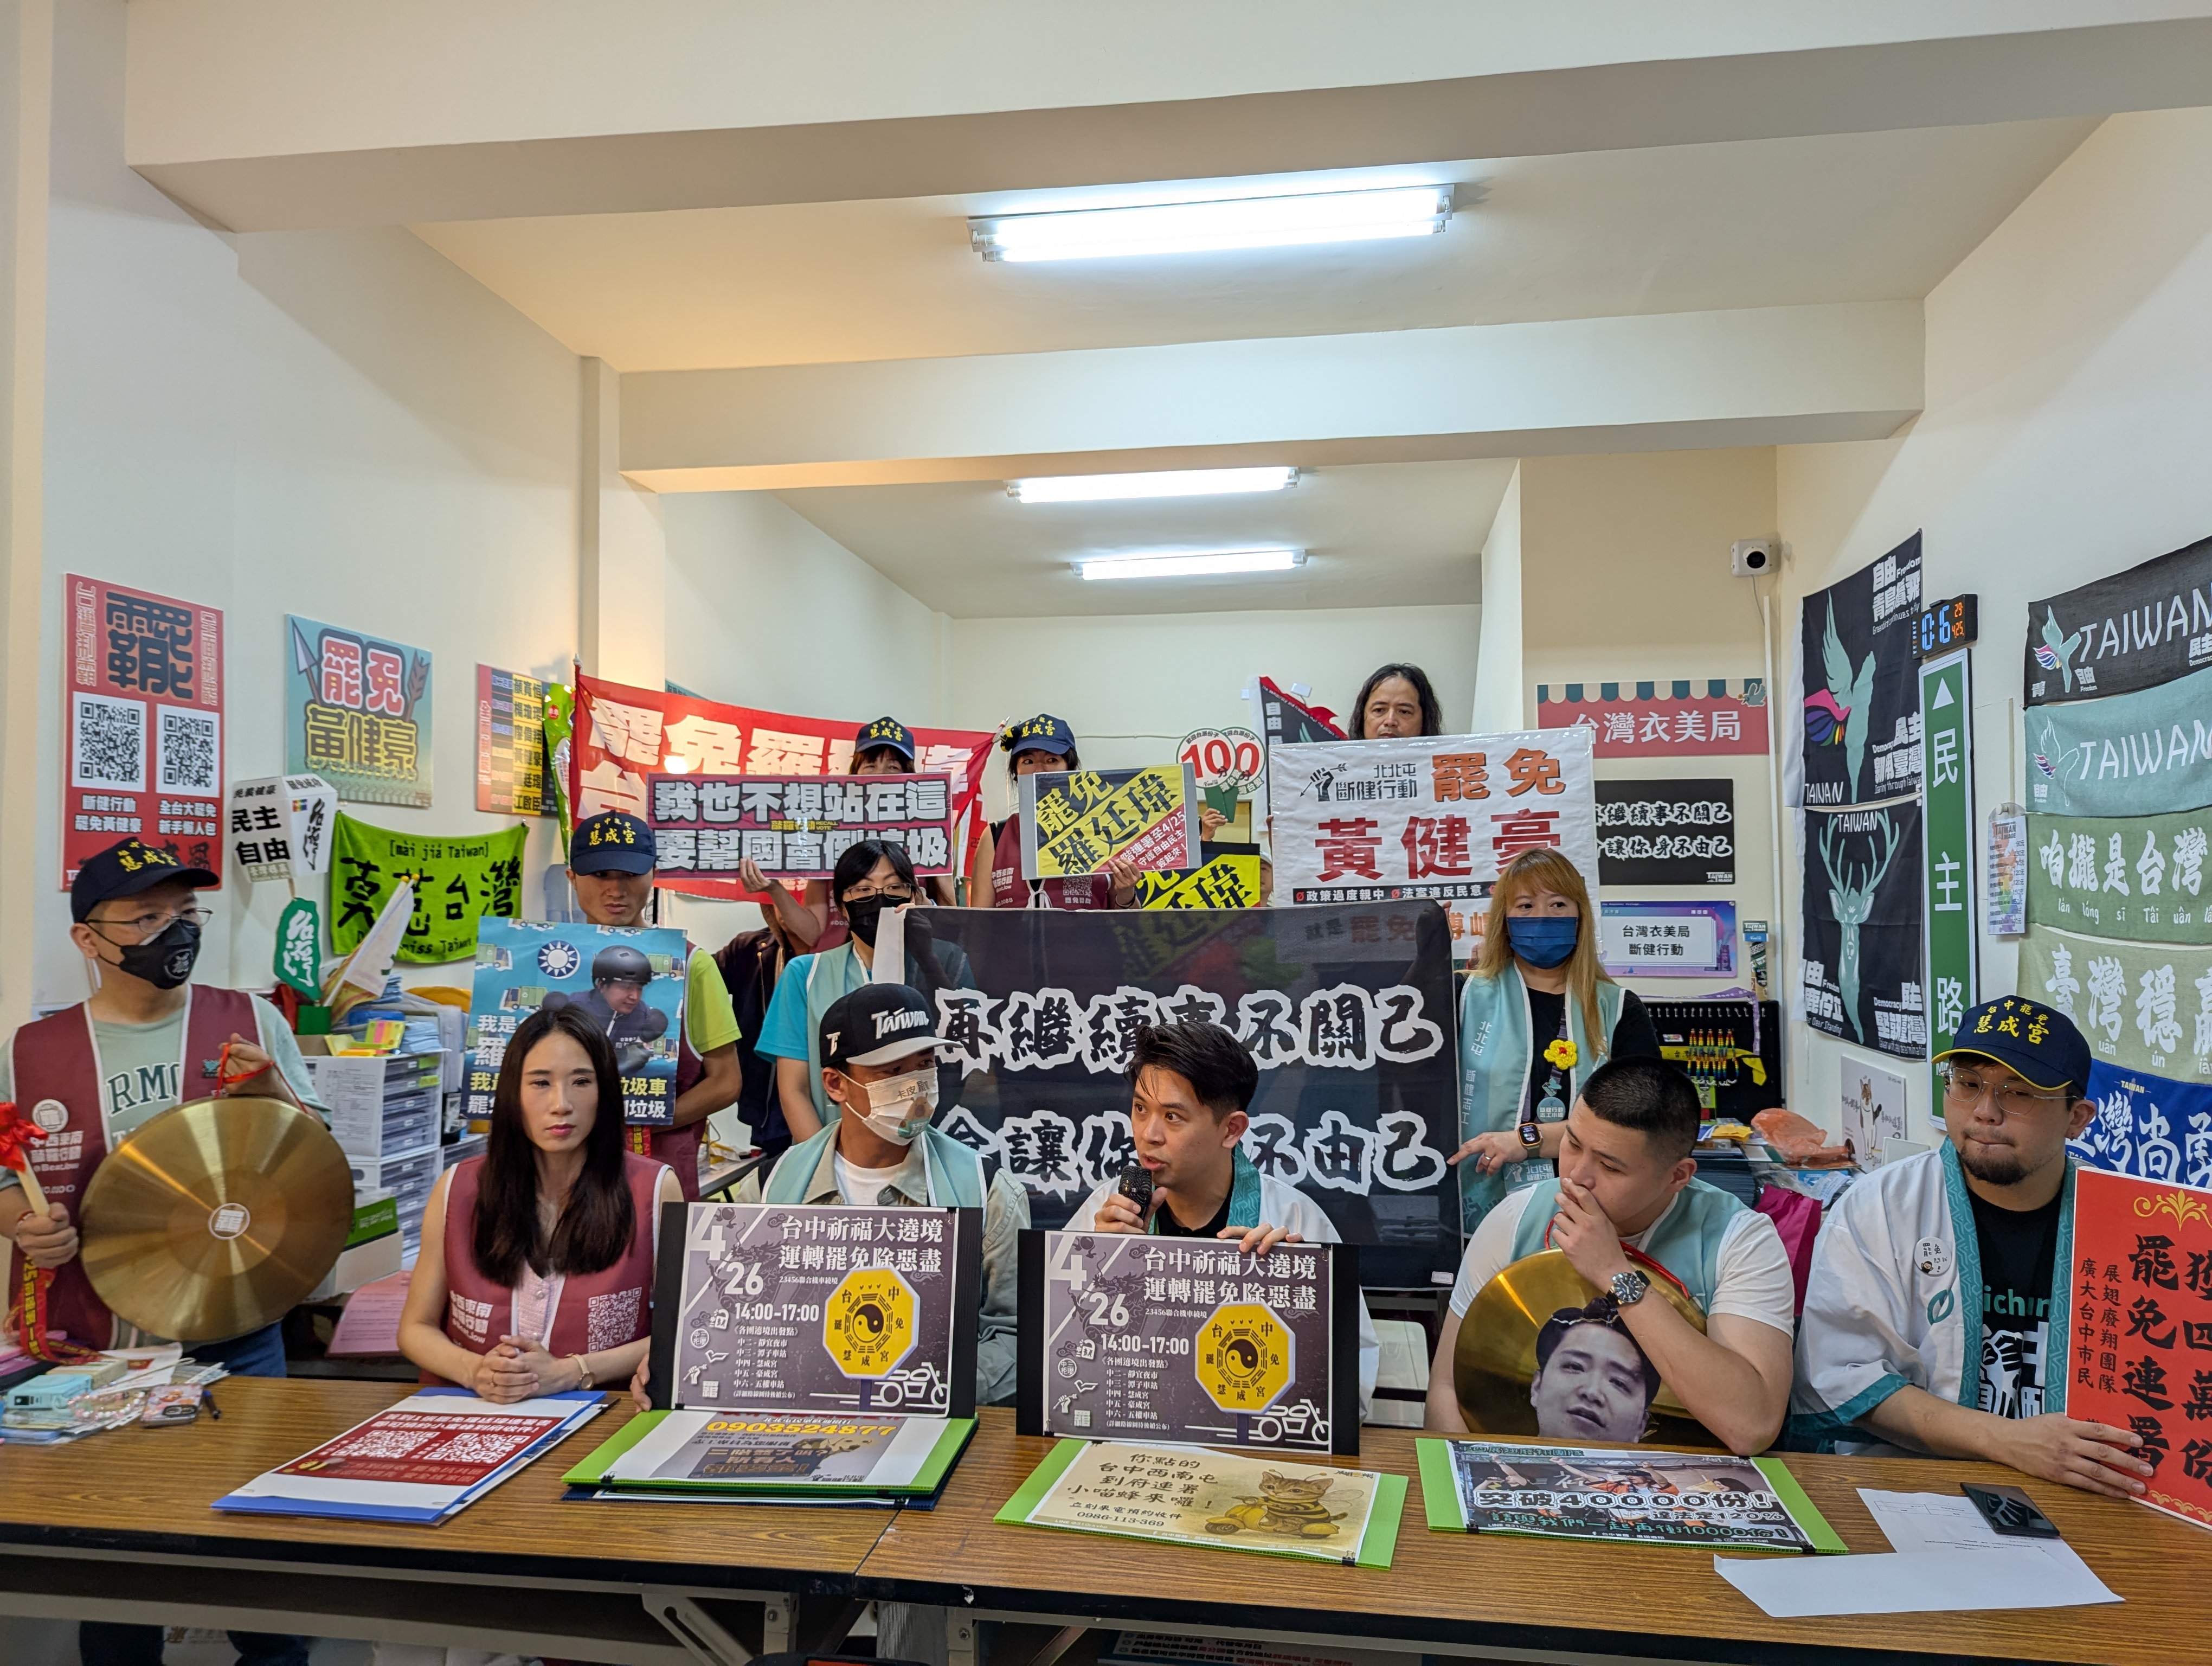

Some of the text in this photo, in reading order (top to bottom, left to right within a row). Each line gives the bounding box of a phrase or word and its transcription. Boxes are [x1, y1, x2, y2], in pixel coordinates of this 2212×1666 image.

[321, 635, 404, 716] 罷免
[870, 728, 903, 742] 慧成宮
[1020, 724, 1056, 737] 慧成宮
[1571, 710, 1741, 746] 台灣衣美局
[1373, 763, 1417, 779] 北北屯
[1431, 748, 1566, 803] 罷免
[654, 780, 947, 823] 我也不想站在這
[1336, 779, 1417, 802] 斷健行動
[159, 800, 217, 818] 全台大罷免
[1037, 772, 1114, 840] 罷免
[75, 815, 142, 833] 罷免黃健豪
[232, 806, 281, 834] 民主
[1049, 773, 1178, 876] 羅廷瑋
[1837, 811, 1879, 833] TAIWAN
[589, 829, 636, 846] 慧成宮
[1137, 829, 1185, 866] 守護自由民主
[1596, 835, 1732, 860] 讓你身不由己
[235, 837, 291, 866] 自由
[2039, 827, 2209, 896] 咱攏是台灣
[1307, 889, 1385, 902] 政策過度親中
[1402, 884, 1482, 899] 法案違反民意
[1933, 728, 1964, 1037] 民主路
[1622, 925, 1690, 938] 台灣衣美局
[1629, 943, 1683, 956] 斷健行動
[1471, 1021, 1492, 1055] 北北屯
[1973, 1014, 2049, 1045] 慧成宮
[625, 1100, 666, 1118] 垃圾
[1461, 1069, 1476, 1125] 斷健志工
[940, 1106, 1446, 1194] 會讓你不由己
[782, 1215, 943, 1242] 台中祈福大遶境
[779, 1245, 943, 1273] 運轉罷免除惡盡
[1144, 1249, 1317, 1280] 台中祈福大遶境
[1144, 1277, 1317, 1311] 運轉罷免除惡盡
[735, 1303, 819, 1322] 14:00-17:00
[2078, 1258, 2098, 1389] 廣大台中市民
[2099, 1265, 2123, 1394] 展翅廢翔團隊
[1101, 1334, 1189, 1355] 14:00-17:00
[2122, 1233, 2178, 1473] 罷免連署
[706, 1421, 897, 1436] 0903524877
[1099, 1463, 1218, 1484] 台中西南屯
[1130, 1453, 1200, 1468] 你點的
[1099, 1476, 1199, 1494] 到府連署
[1069, 1501, 1182, 1520] 立刻來電預約收件
[1077, 1511, 1165, 1527] 0986-113-369
